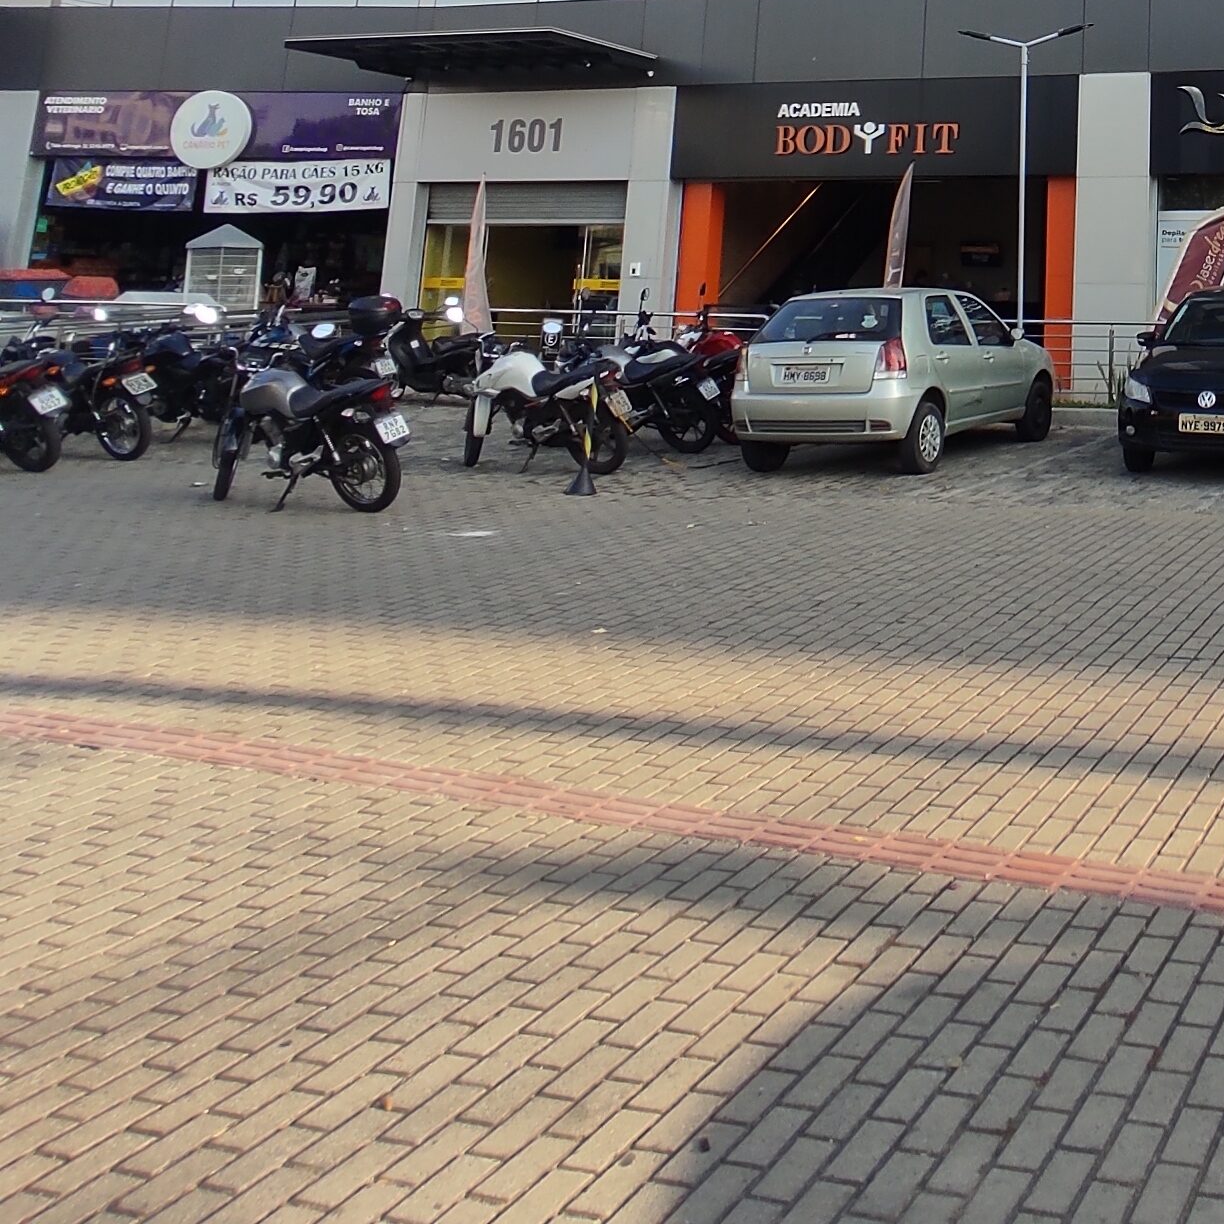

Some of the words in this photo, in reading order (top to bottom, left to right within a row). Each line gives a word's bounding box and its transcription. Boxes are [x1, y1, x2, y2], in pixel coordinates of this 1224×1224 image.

[348, 98, 382, 107] BANHO
[384, 98, 390, 107] E
[778, 102, 861, 118] ACADEMIA
[356, 107, 379, 116] TOSA
[489, 117, 564, 153] 1601
[213, 165, 257, 181] RAÇÃO
[261, 168, 297, 180] PARA
[302, 165, 336, 179] CÃES
[343, 165, 360, 176] 15
[364, 162, 384, 175] KG
[106, 183, 114, 194] E
[114, 183, 145, 194] GANHE
[146, 184, 153, 195] O
[155, 183, 189, 195] QUINTO
[270, 182, 358, 208] 59,90
